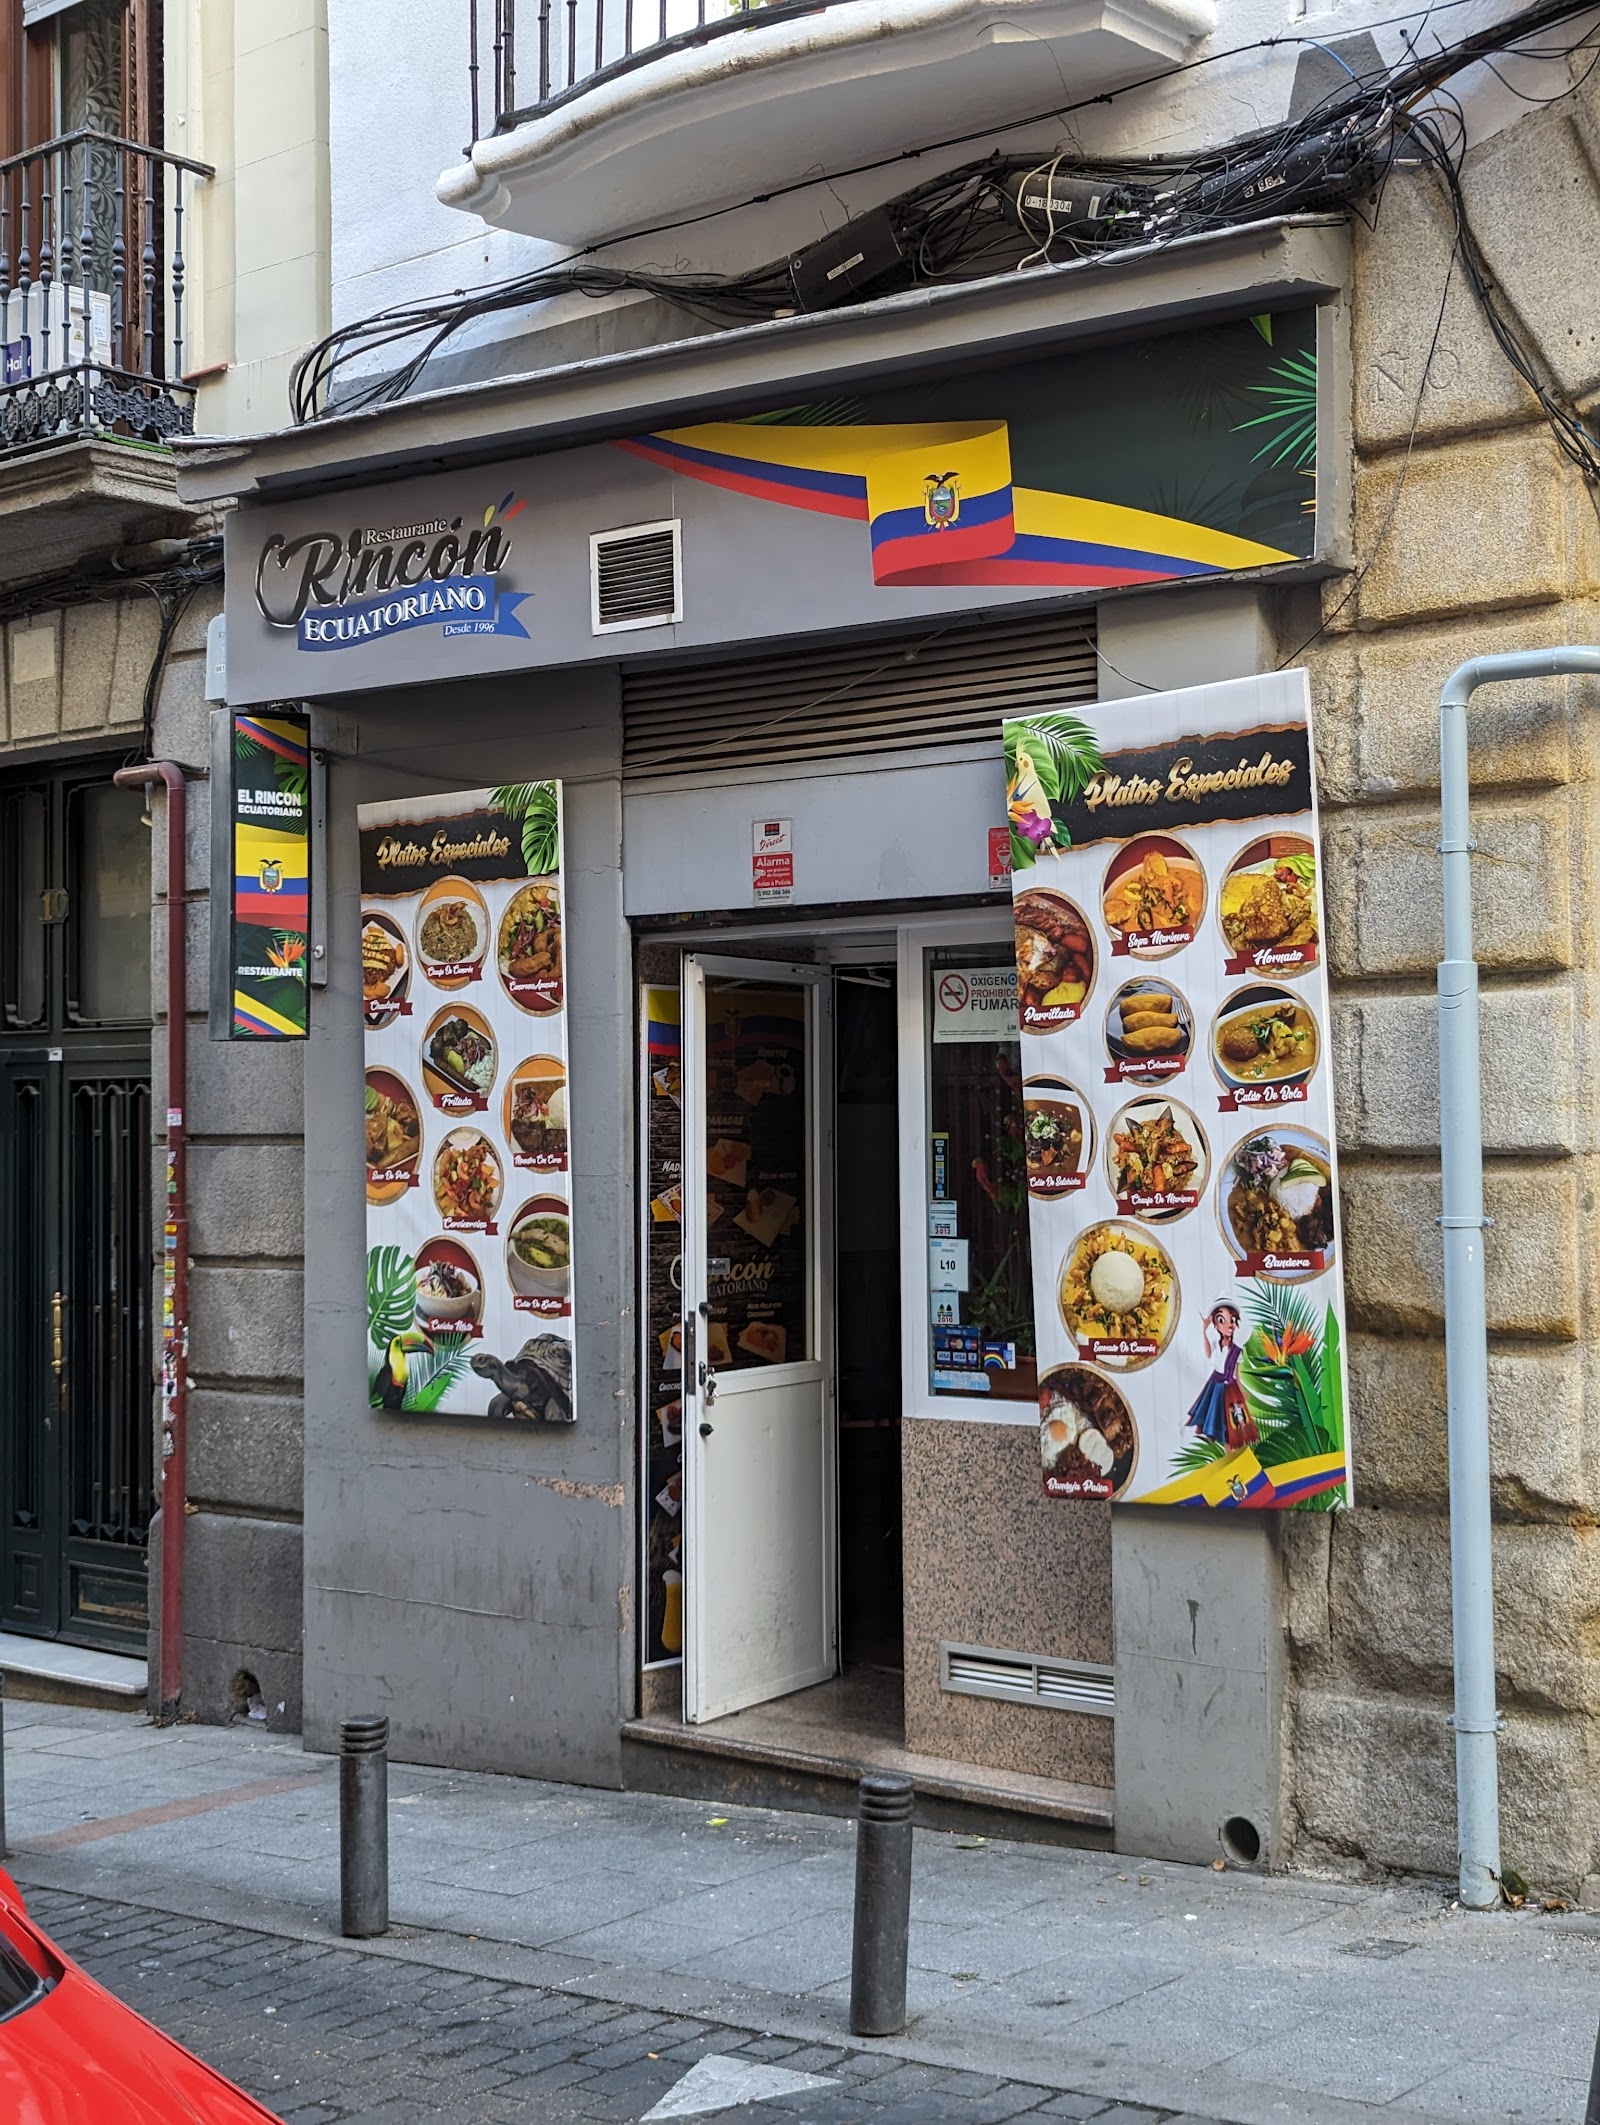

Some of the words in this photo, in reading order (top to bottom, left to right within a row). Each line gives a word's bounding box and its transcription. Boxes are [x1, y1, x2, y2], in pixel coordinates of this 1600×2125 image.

[365, 517, 448, 546] Restaurante
[254, 514, 513, 629] Rincón
[304, 585, 486, 644] ECUATORIANO
[444, 624, 471, 636] Desde
[473, 622, 495, 634] 1996
[1083, 771, 1163, 813] Platos
[1164, 751, 1296, 803] Especiales
[237, 789, 252, 803] EL
[255, 790, 302, 806] RINCON
[237, 805, 303, 818] ECUATORIANO
[376, 836, 429, 871] Platos
[430, 829, 512, 868] Especiales
[756, 857, 790, 868] Alarma
[1128, 933, 1149, 949] Sopa
[1149, 930, 1190, 945] Marinera
[1252, 948, 1304, 965] Hornado
[237, 966, 303, 978] RESTAURANTE
[971, 989, 1018, 998] PROHIBIDO
[971, 999, 1019, 1010] FUMAR
[1024, 1006, 1076, 1023] Parrillada
[1233, 1088, 1262, 1103] Caldo
[1263, 1086, 1278, 1101] De
[1280, 1085, 1303, 1100] Bola
[940, 1260, 956, 1270] L10
[1262, 1254, 1311, 1269] Bandera
[1046, 1477, 1080, 1493] Bandeja
[1082, 1479, 1107, 1493] Paisa
